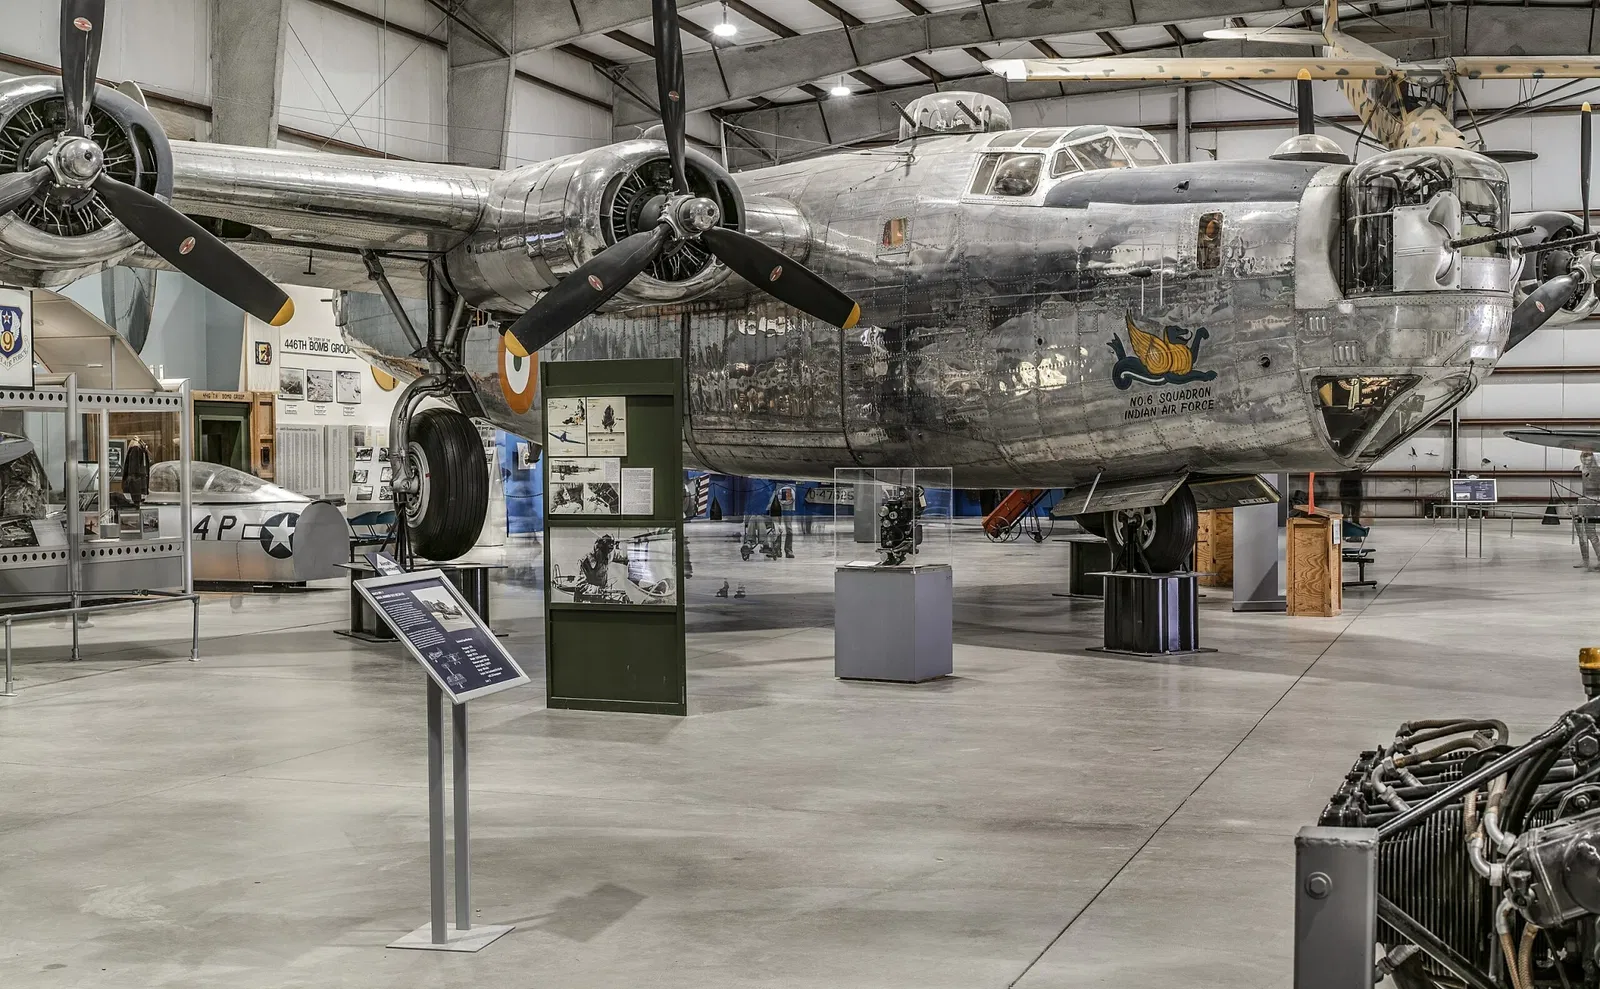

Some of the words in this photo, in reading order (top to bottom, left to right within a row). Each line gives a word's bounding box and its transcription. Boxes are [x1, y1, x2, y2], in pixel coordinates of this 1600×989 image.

[3, 332, 13, 351] 9
[284, 339, 307, 350] 446TH
[309, 341, 329, 352] BOMB
[330, 343, 351, 355] GROU
[1159, 387, 1212, 404] SQUADRON
[1124, 407, 1157, 420] INDIAN
[1161, 404, 1177, 415] AIR
[1180, 399, 1215, 413] FORCE
